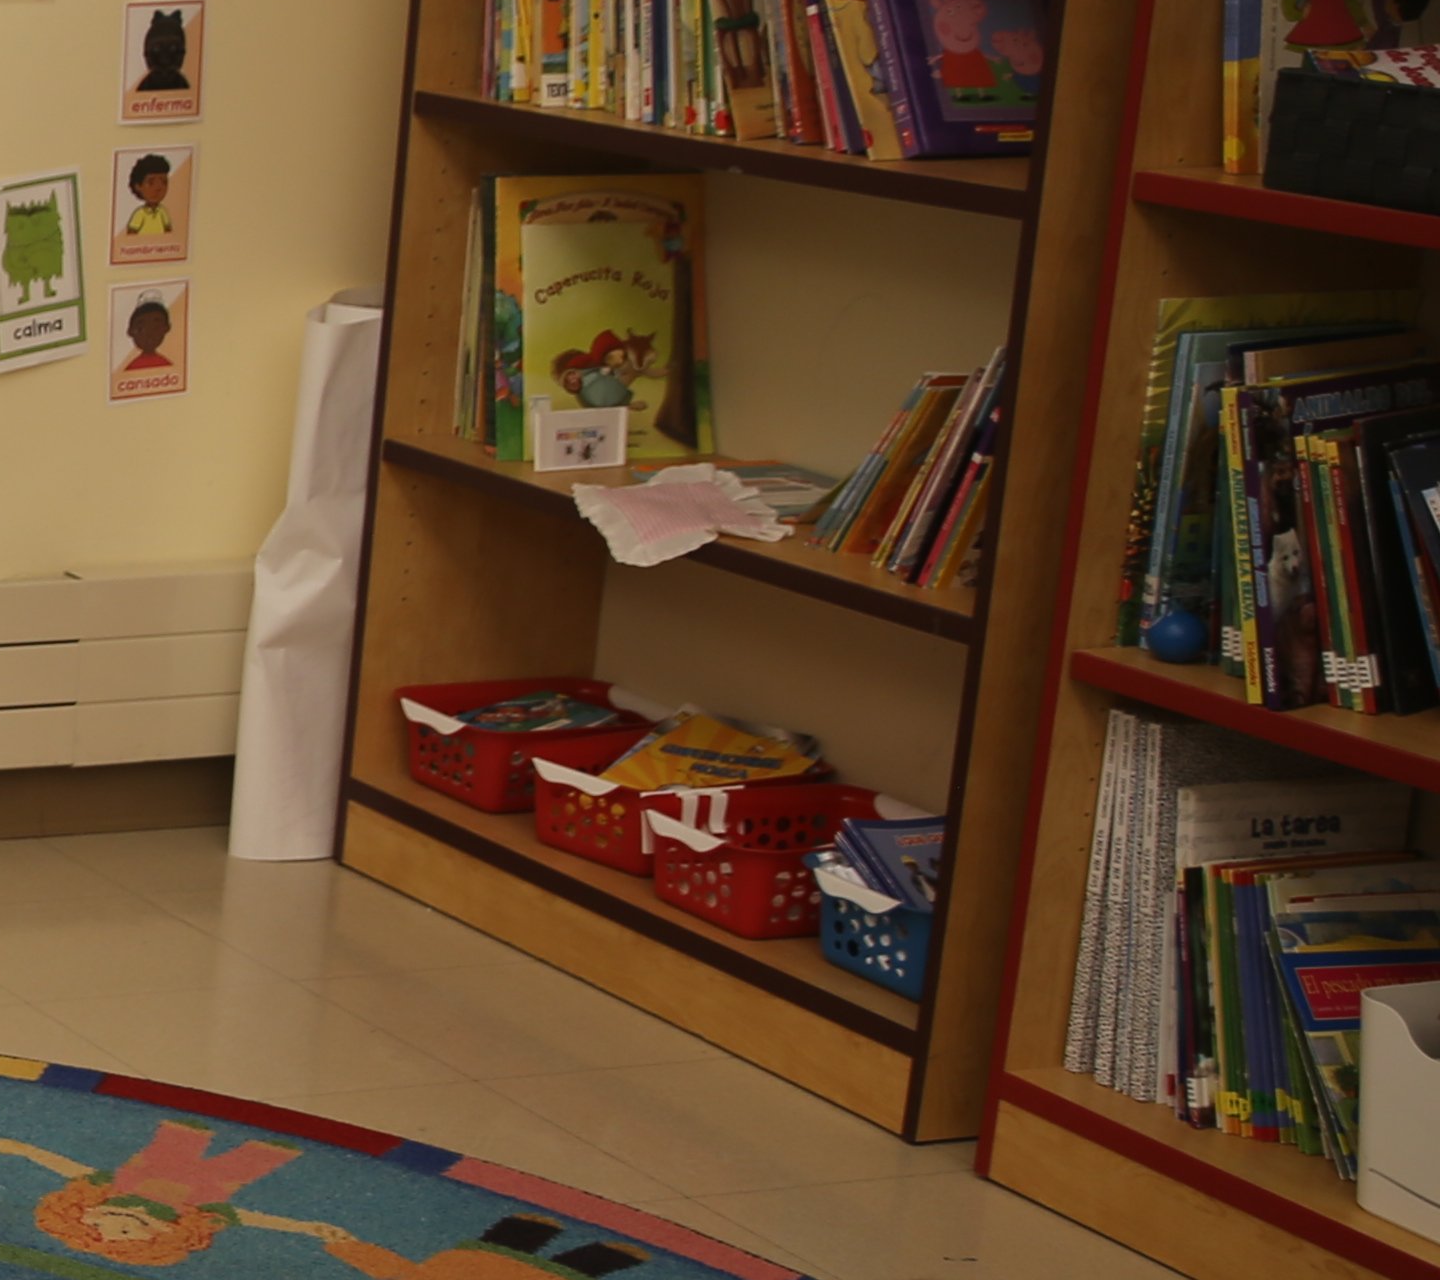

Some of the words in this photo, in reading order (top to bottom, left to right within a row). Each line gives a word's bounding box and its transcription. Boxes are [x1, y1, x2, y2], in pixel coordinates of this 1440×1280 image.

[132, 95, 194, 115] enferma
[533, 264, 624, 306] Caperucita
[11, 315, 65, 343] calma
[117, 371, 179, 393] cansado
